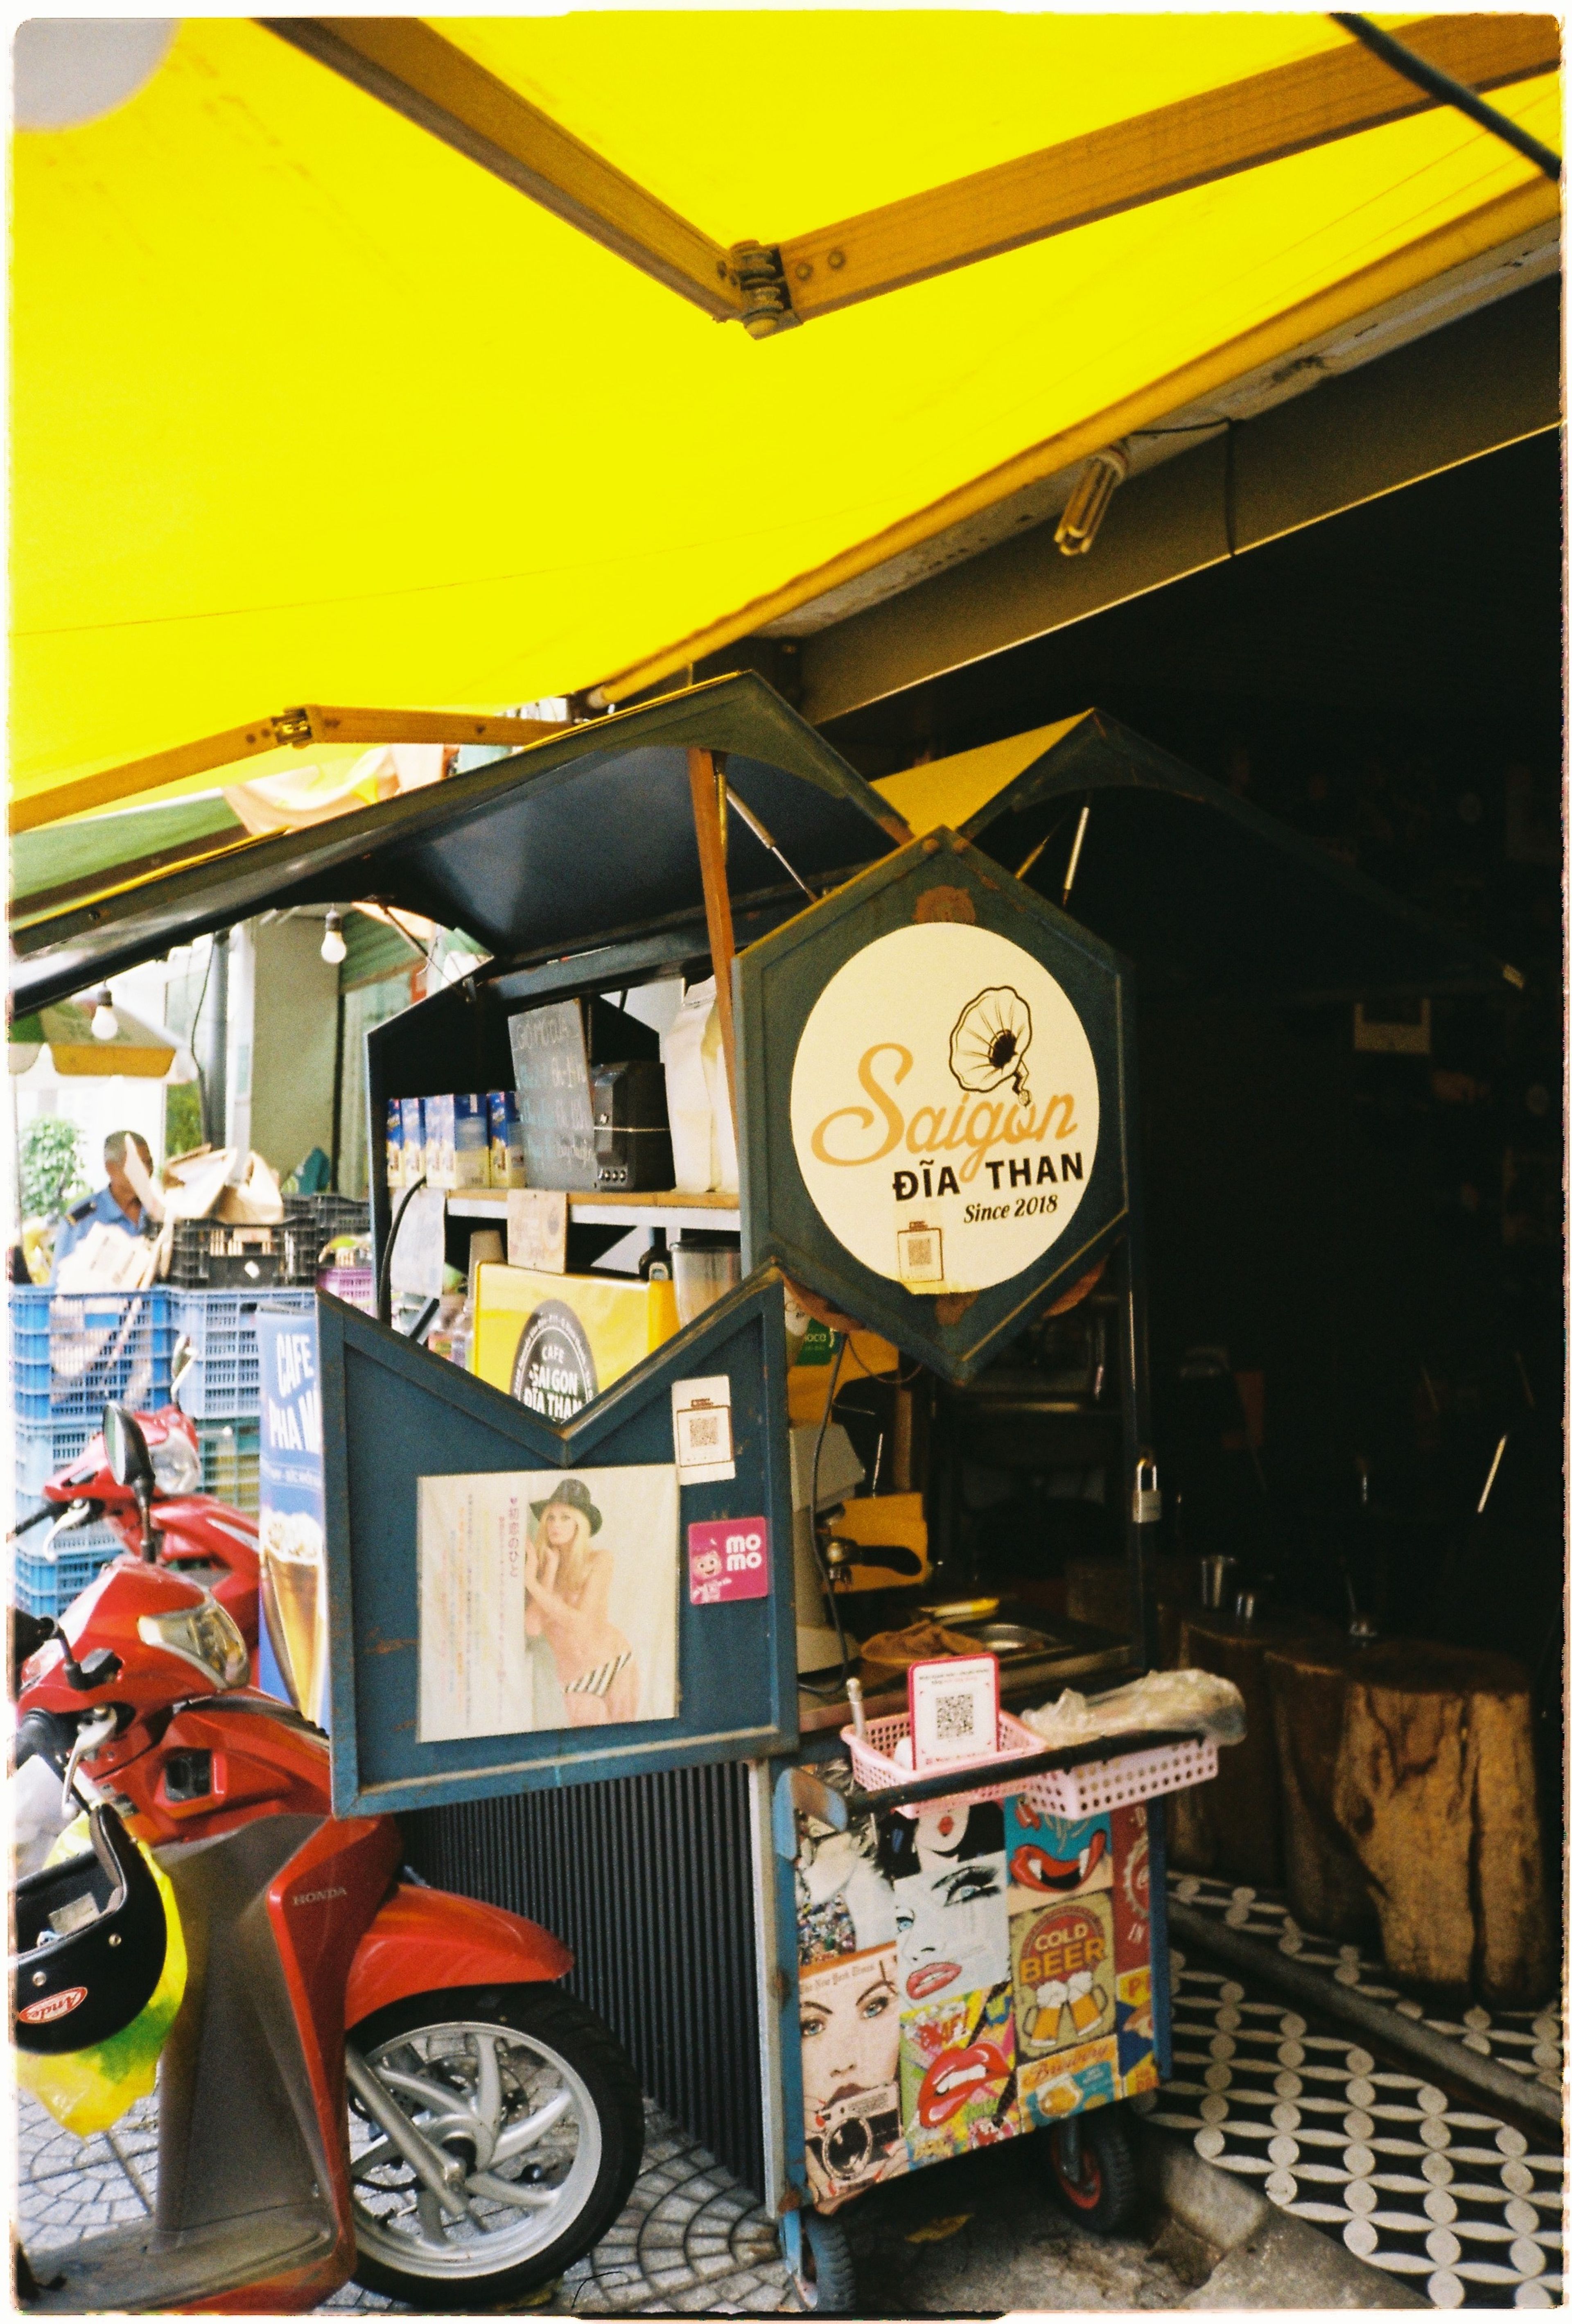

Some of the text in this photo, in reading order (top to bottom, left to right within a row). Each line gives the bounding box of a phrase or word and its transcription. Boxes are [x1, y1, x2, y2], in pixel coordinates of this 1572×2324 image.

[811, 1042, 1078, 1183] Saigon
[892, 1152, 1084, 1201] ĐĨA THAN
[963, 1194, 1058, 1223] Since 2018
[293, 1887, 347, 1906] HONDA
[1035, 1923, 1089, 1951] COLD
[1019, 1936, 1105, 1984] BEER
